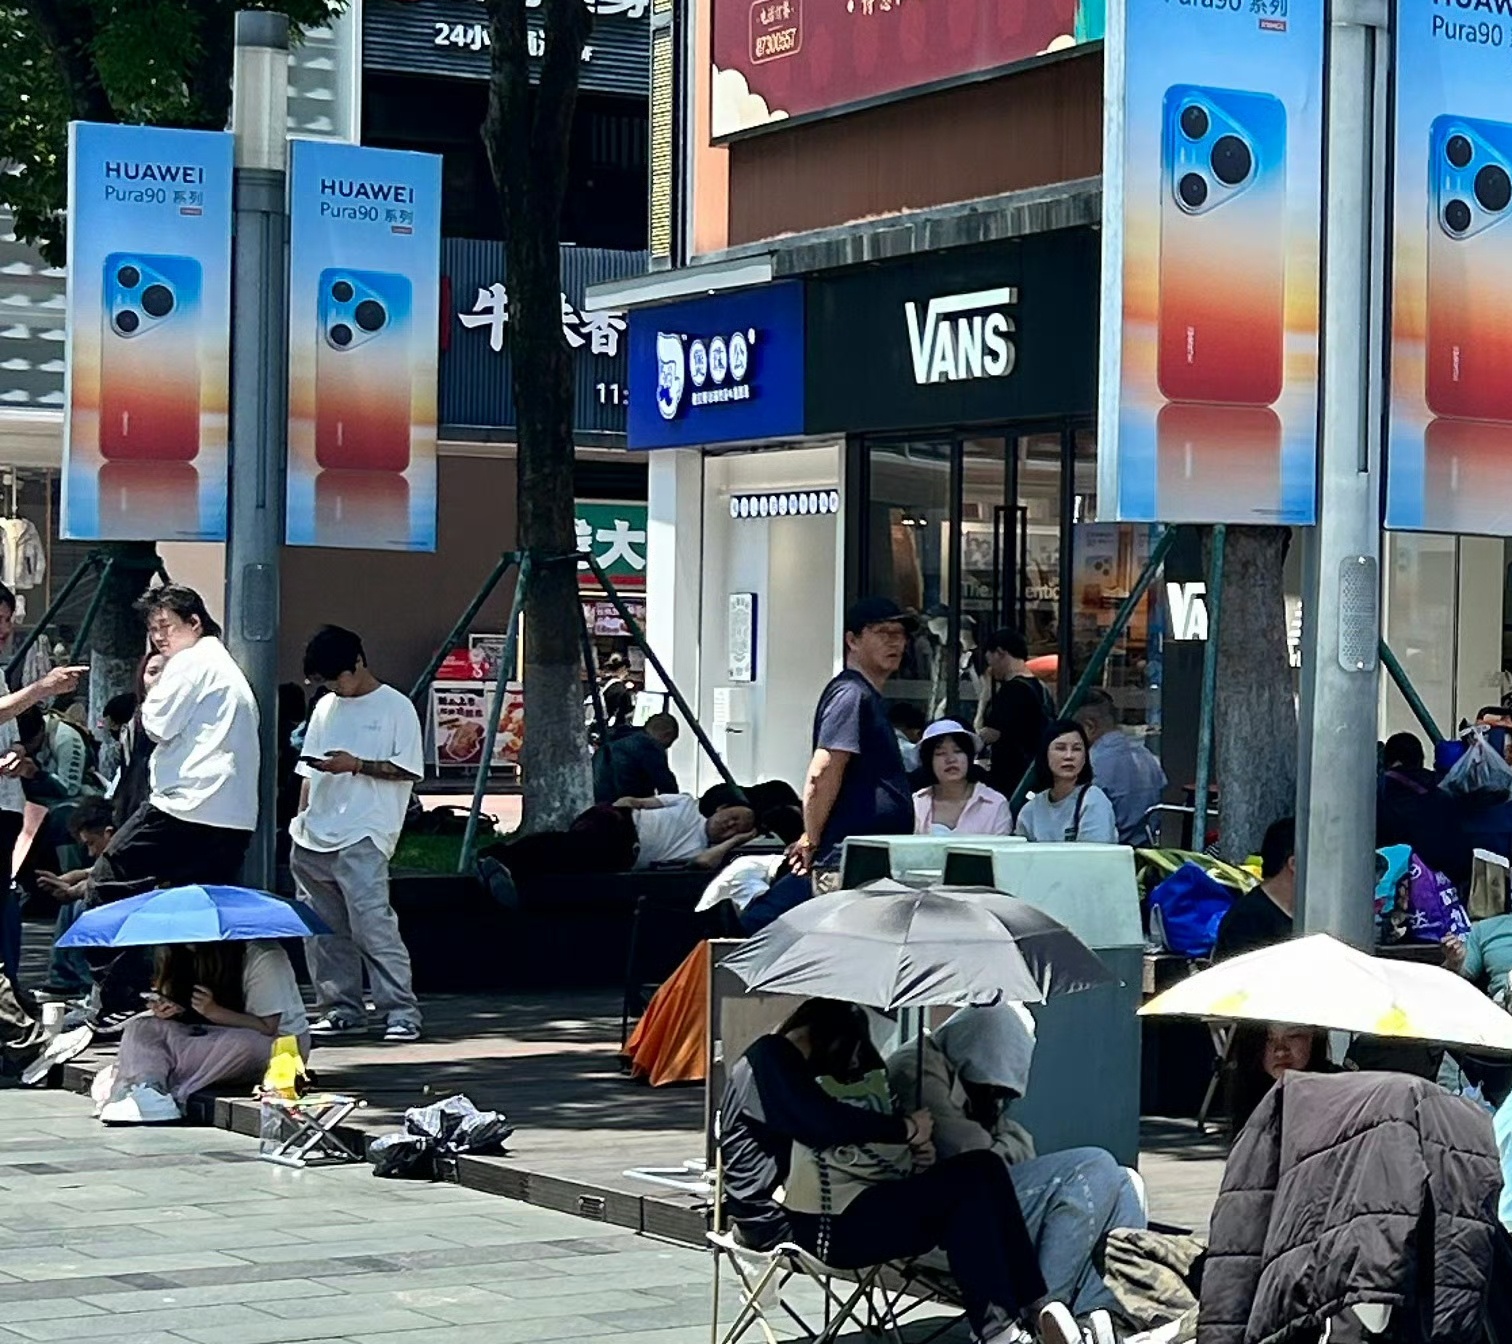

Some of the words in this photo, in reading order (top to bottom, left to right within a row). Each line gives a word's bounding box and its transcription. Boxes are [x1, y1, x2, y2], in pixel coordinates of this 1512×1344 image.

[1432, 14, 1503, 48] Pura90
[105, 161, 204, 185] HUAWEI
[105, 185, 166, 205] Pura90
[172, 190, 203, 205] 系列
[320, 178, 414, 204] HUAWEI
[320, 201, 379, 222] Pura90
[384, 208, 414, 225] 系列
[904, 287, 1018, 384] VANS
